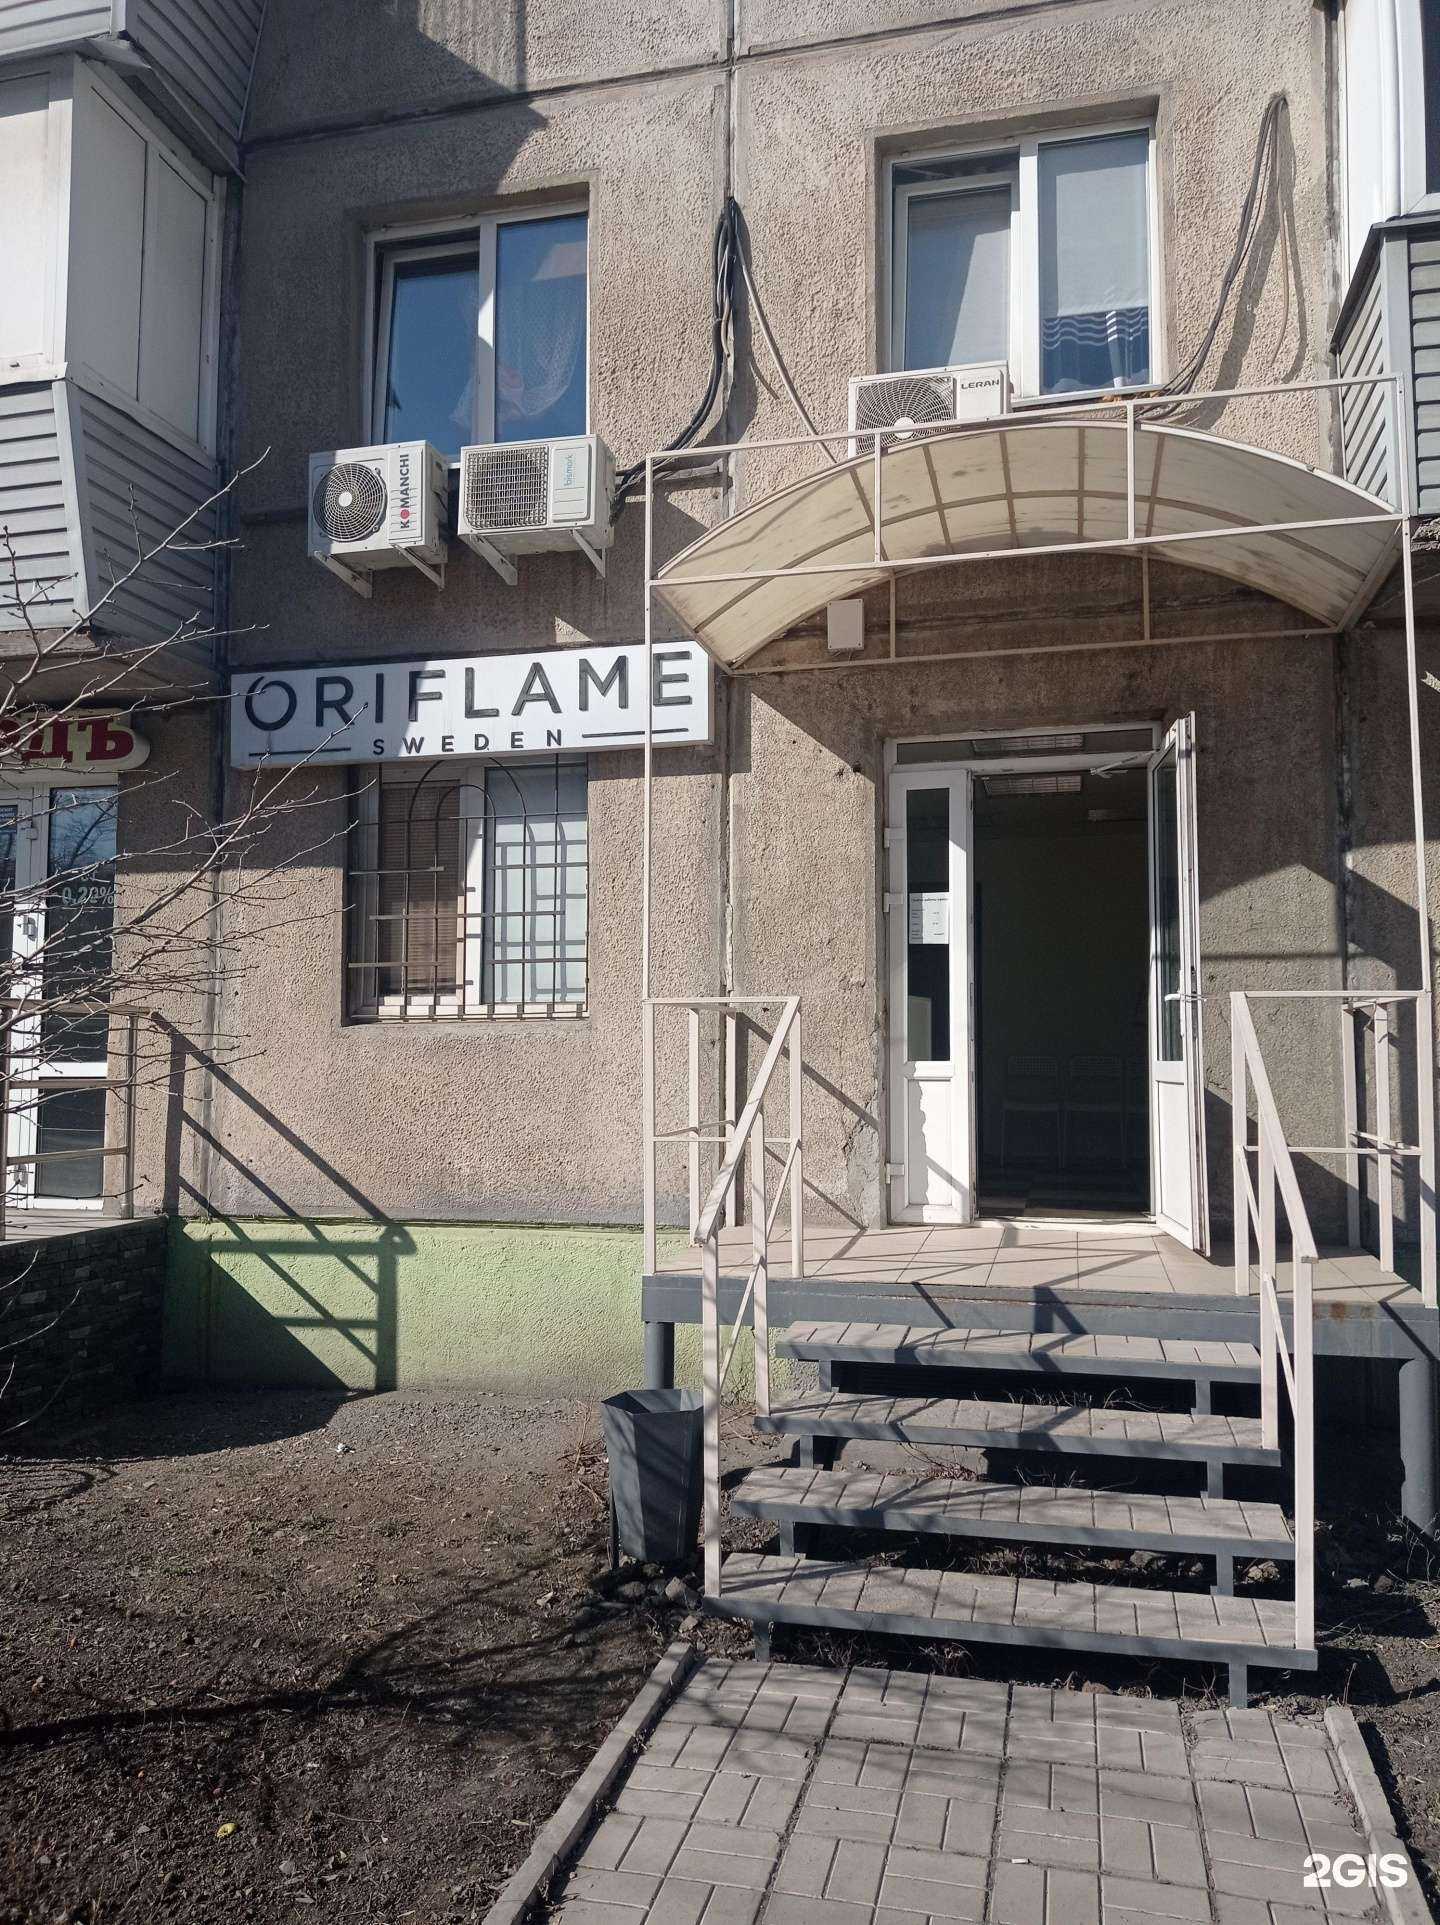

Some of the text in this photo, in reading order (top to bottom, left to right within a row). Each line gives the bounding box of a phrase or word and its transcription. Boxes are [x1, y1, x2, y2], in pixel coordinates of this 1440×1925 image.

[961, 379, 1000, 390] LERAN
[399, 454, 410, 529] KOMANCHI
[245, 650, 693, 731] ORIFLAME
[372, 729, 562, 756] SWEDEN
